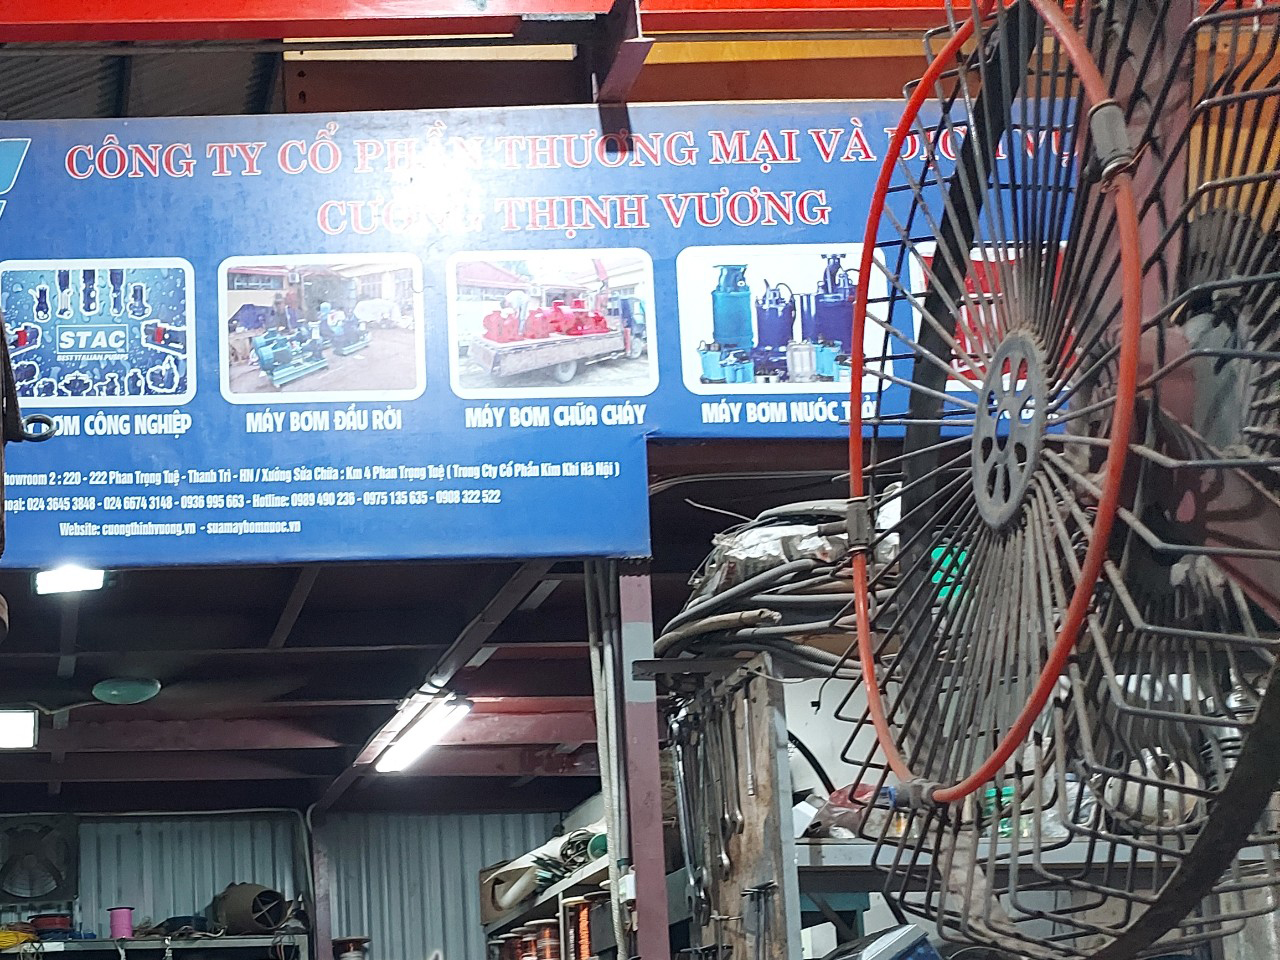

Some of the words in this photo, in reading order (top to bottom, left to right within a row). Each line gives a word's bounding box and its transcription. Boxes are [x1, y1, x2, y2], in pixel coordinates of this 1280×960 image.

[65, 134, 196, 179] CÔNG
[206, 141, 267, 177] TY
[277, 121, 342, 175] CỔ
[496, 127, 699, 169] THƯƠNG
[708, 129, 800, 173] MẠI
[808, 117, 877, 165] VÀ
[501, 193, 650, 239] THỊNH
[657, 186, 832, 229] VƯƠNG
[59, 330, 126, 349] STAC
[246, 407, 287, 433] MÁY
[289, 410, 330, 432] BƠM
[371, 404, 402, 430] RỜI
[465, 402, 506, 428] MÁY
[509, 405, 551, 427] BƠM
[553, 401, 598, 427] CHỮA
[601, 400, 647, 425] CHÁY
[701, 398, 743, 423] MÁY
[746, 401, 787, 423] BƠM
[791, 396, 839, 422] NƯỚC
[84, 410, 130, 435] CÔNG
[134, 411, 192, 439] NGHIỆP
[4, 471, 47, 486] howroom
[49, 471, 56, 485] 2
[63, 471, 81, 485] 220
[89, 470, 107, 485] 222
[108, 470, 133, 485] Phan
[135, 470, 162, 487] Trọng
[163, 469, 180, 487] Tuệ
[187, 469, 217, 484] Thanh
[239, 468, 254, 483] HN
[346, 465, 362, 480] Km
[364, 465, 371, 480] 4
[372, 465, 397, 480] Phan
[399, 464, 426, 482] Trọng
[481, 463, 498, 480] Cty
[540, 462, 561, 477] Kim
[26, 497, 45, 511] 024
[46, 497, 71, 511] 3645
[72, 496, 96, 511] 3848
[103, 496, 122, 510] 024
[123, 496, 147, 510] 6674
[148, 495, 173, 510] 3148
[181, 495, 205, 509] 0936
[206, 494, 224, 509] 995
[226, 494, 245, 509] 663
[252, 493, 290, 508] Hotline:
[317, 492, 335, 506] 490
[336, 491, 355, 506] 236
[363, 491, 388, 505] 0975
[389, 491, 408, 505] 135
[408, 490, 428, 505] 635
[436, 490, 460, 504] 0908
[461, 489, 481, 504] 322
[482, 489, 501, 504] 522
[59, 521, 101, 536] Website:
